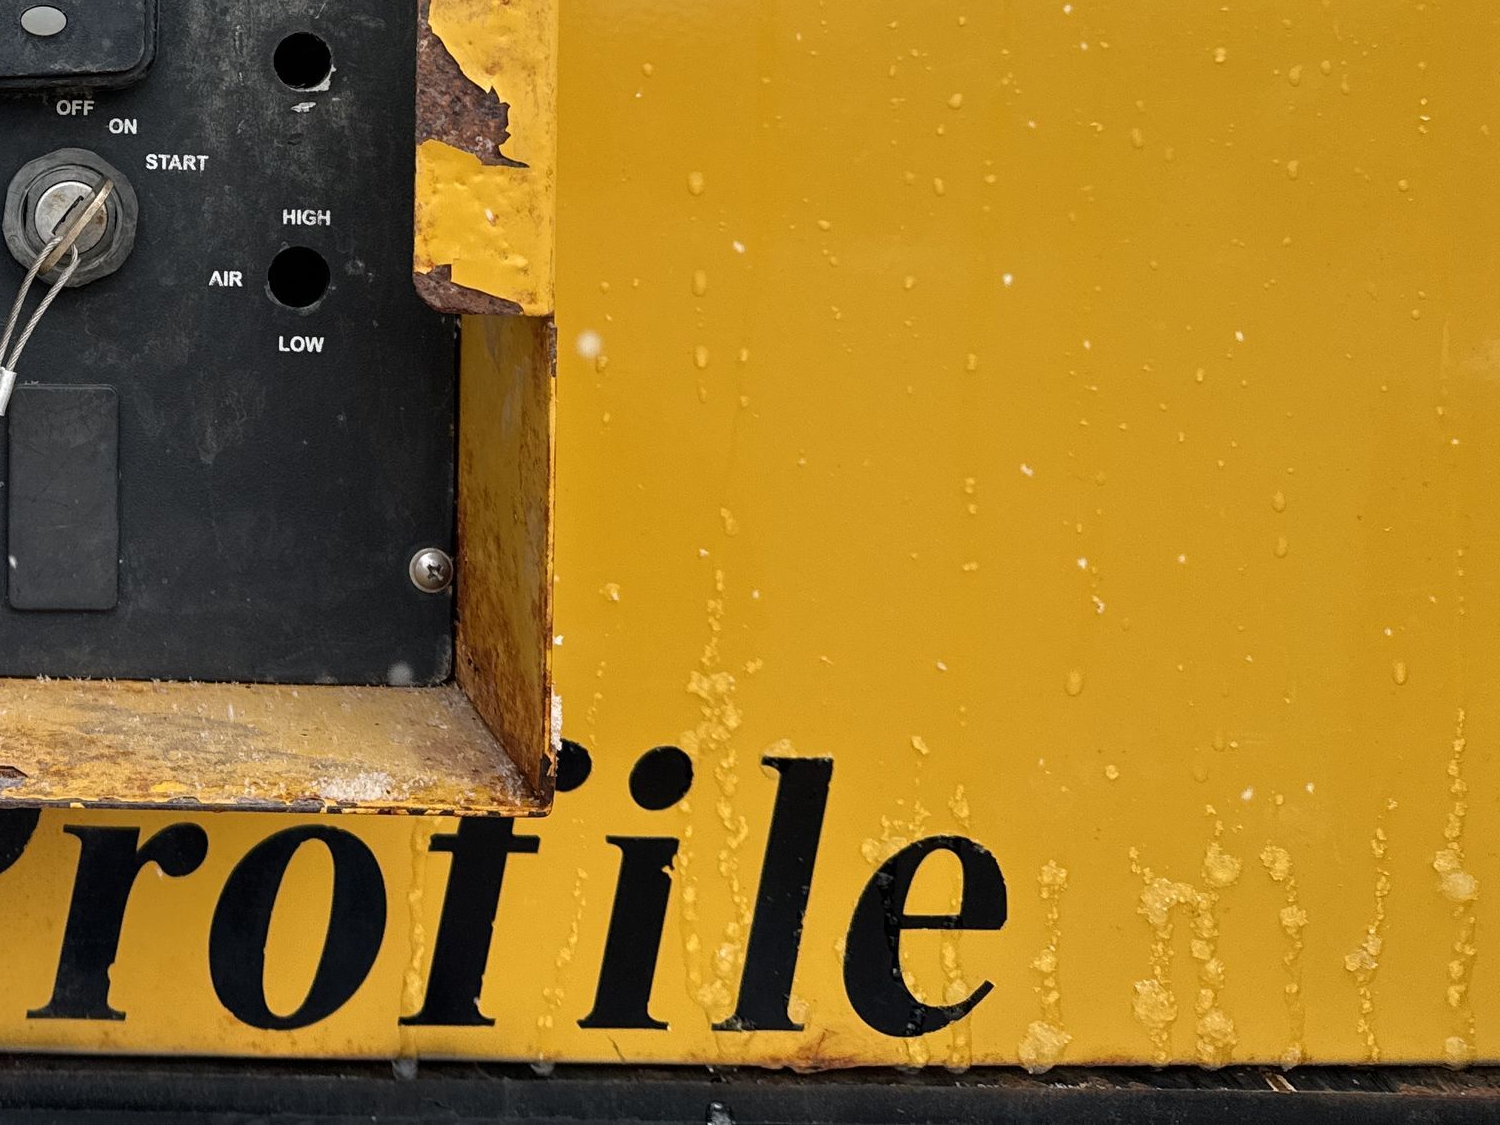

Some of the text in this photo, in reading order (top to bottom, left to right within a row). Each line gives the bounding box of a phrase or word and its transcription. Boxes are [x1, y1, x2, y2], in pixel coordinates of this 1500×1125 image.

[56, 99, 95, 116] OFF
[108, 118, 138, 135] ON
[145, 153, 209, 171] START
[282, 209, 331, 226] HIGH
[208, 270, 243, 287] AIR
[278, 335, 325, 353] LOW
